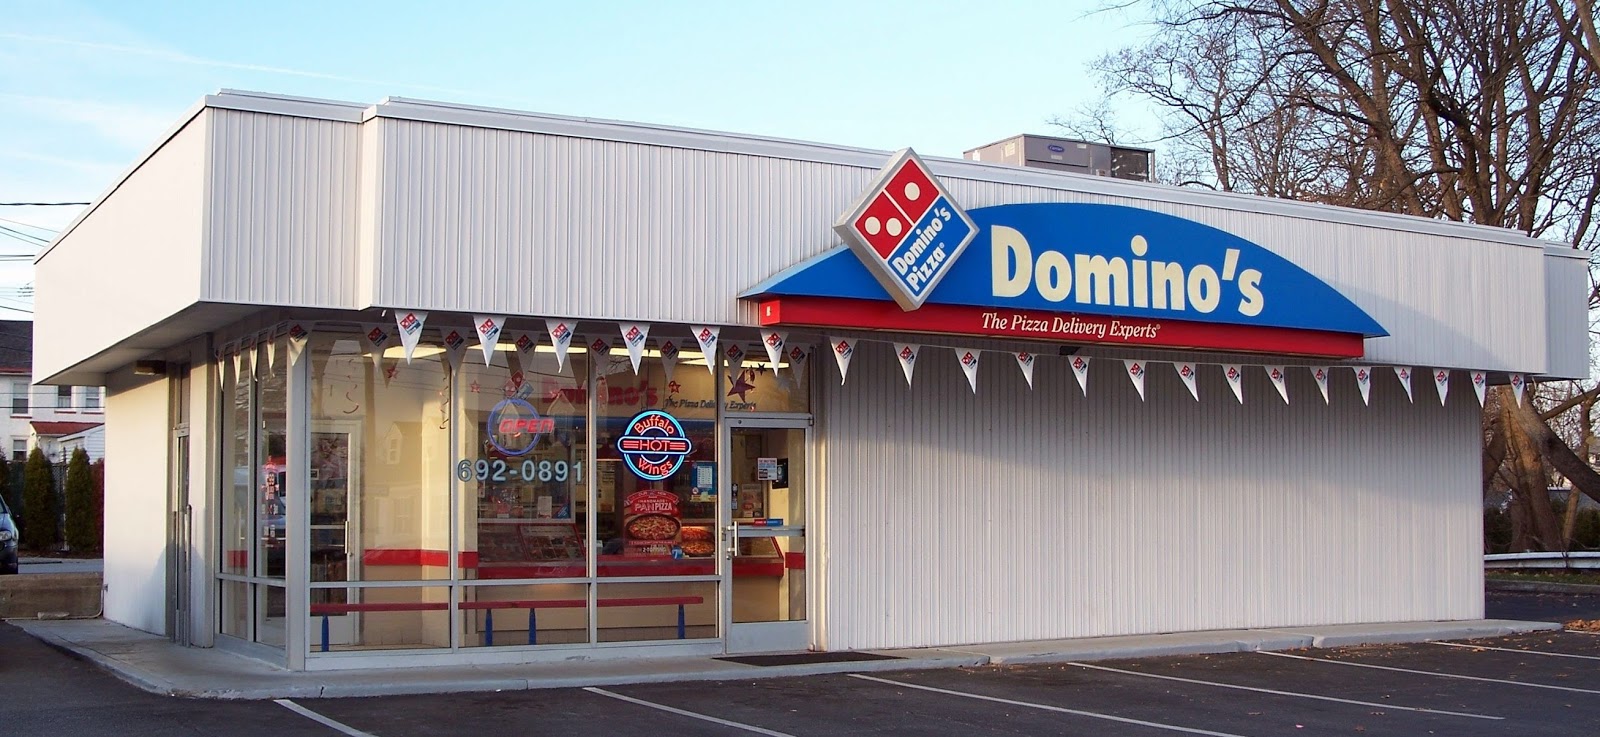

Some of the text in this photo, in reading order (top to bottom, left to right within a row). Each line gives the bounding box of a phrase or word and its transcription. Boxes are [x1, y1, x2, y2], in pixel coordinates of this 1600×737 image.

[892, 207, 951, 276] Domino's
[991, 225, 1264, 317] Domino's
[982, 312, 1007, 330] The
[1010, 314, 1049, 332] Pizza
[1051, 317, 1107, 338] Delivery
[499, 418, 555, 434] OPEN
[634, 414, 675, 434] Buffalo
[640, 440, 671, 452] HOT
[457, 459, 583, 483] 692-0891
[638, 457, 673, 477] Wings
[634, 502, 673, 511] PAN PIZZA
